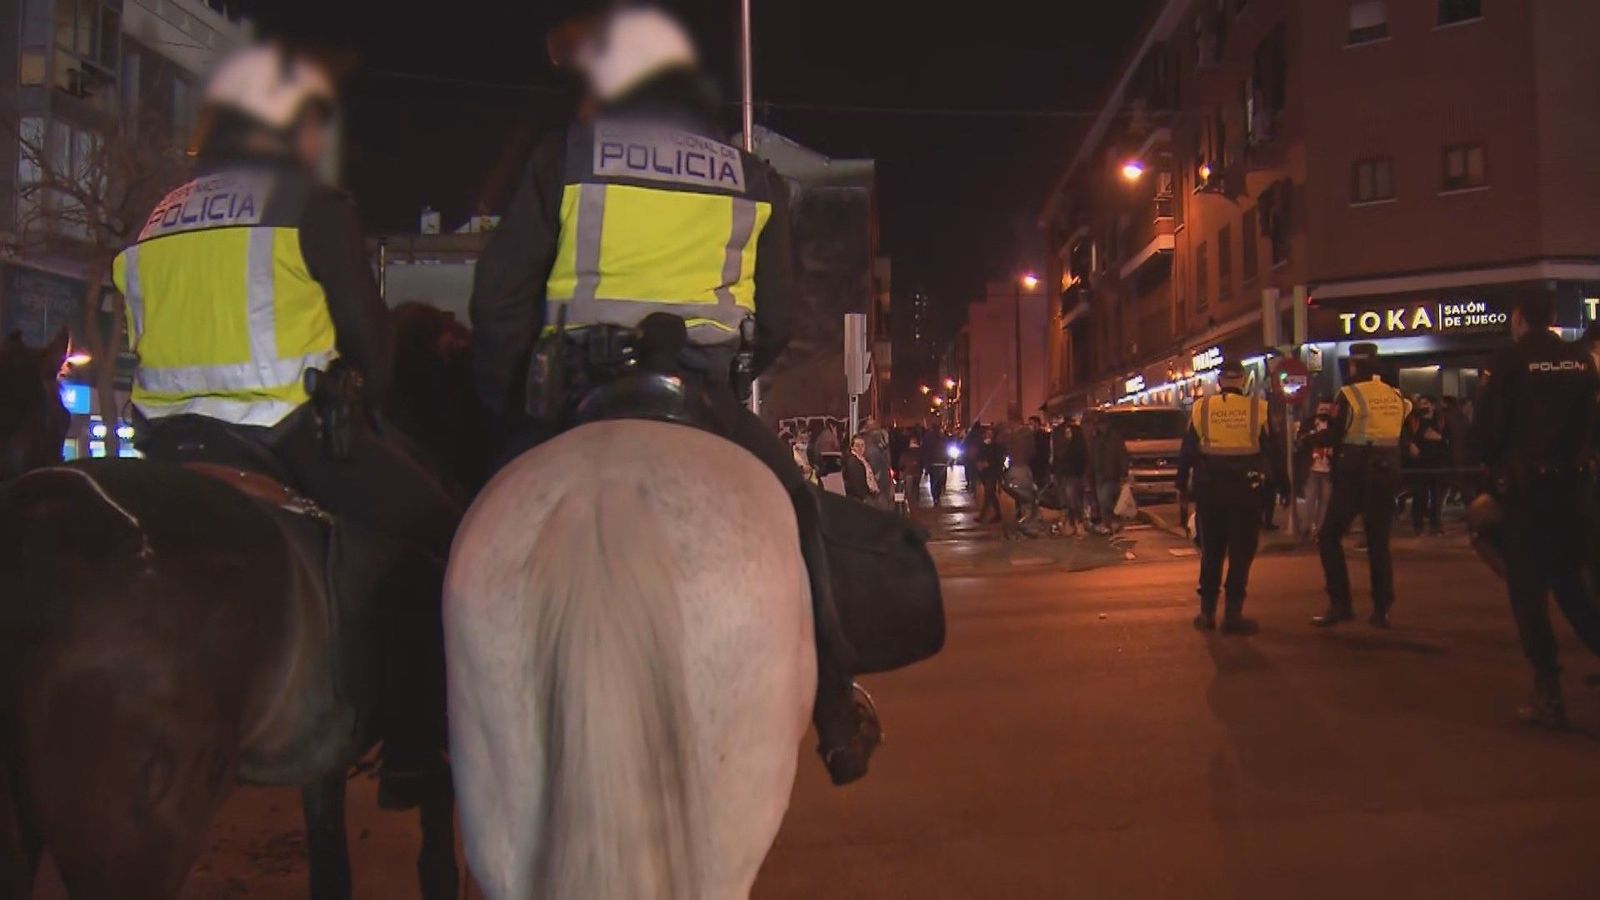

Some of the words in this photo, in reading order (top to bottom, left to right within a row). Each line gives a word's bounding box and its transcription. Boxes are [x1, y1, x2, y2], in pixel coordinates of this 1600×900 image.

[601, 142, 738, 184] POLICIA
[147, 193, 255, 228] POLICIA
[1444, 301, 1485, 315] SALÓN
[1339, 307, 1432, 335] TOKA
[1444, 316, 1461, 327] DE
[1465, 313, 1507, 326] JUEGO
[1528, 361, 1585, 371] POLICIA
